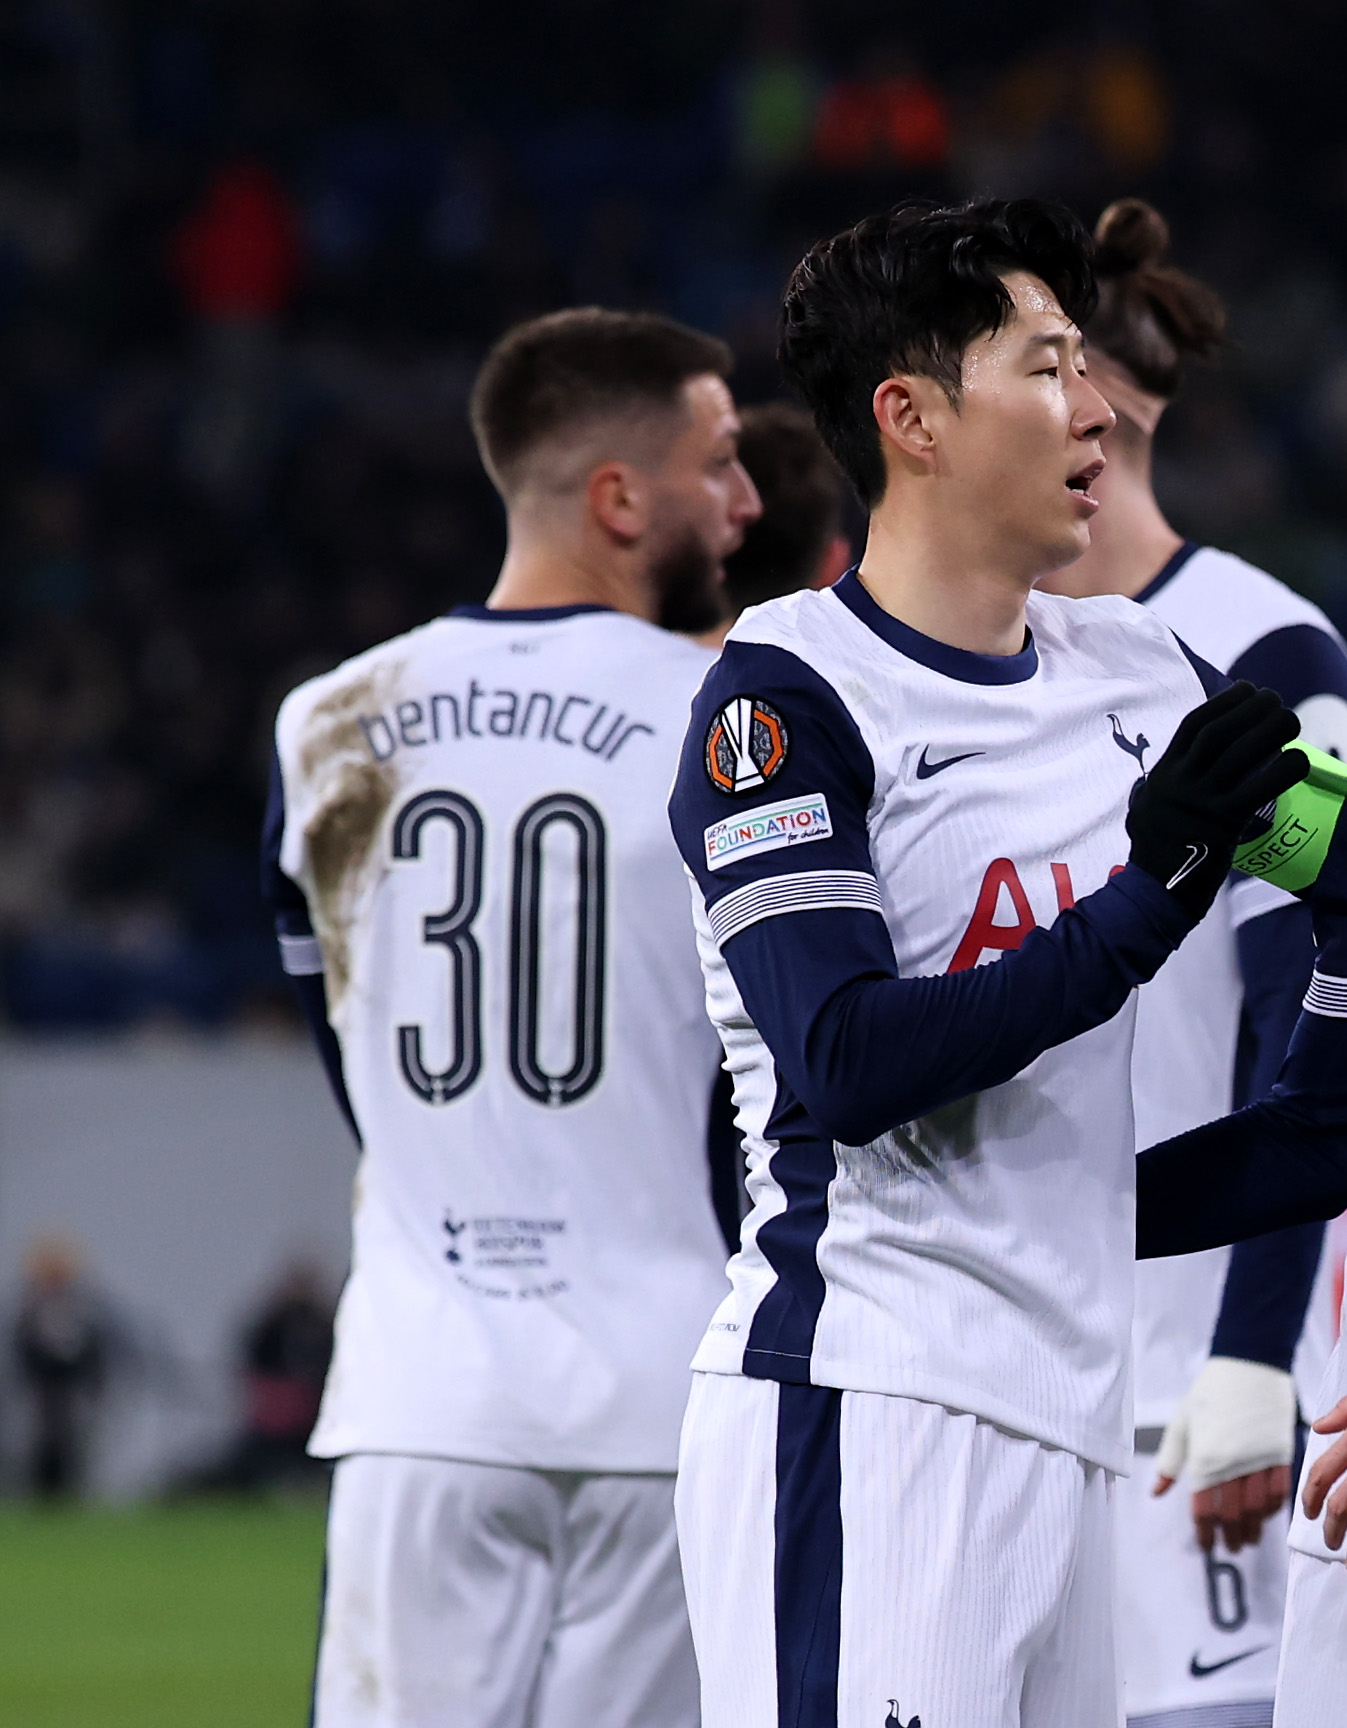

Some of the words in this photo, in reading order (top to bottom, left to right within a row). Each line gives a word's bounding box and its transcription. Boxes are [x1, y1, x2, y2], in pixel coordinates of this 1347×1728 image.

[357, 678, 656, 764] bentancur
[707, 823, 728, 840] UEFA
[708, 807, 827, 856] FOUNDATION
[787, 831, 799, 844] for
[800, 827, 829, 839] children
[1237, 818, 1309, 873] ESPECT
[393, 789, 607, 1105] 30
